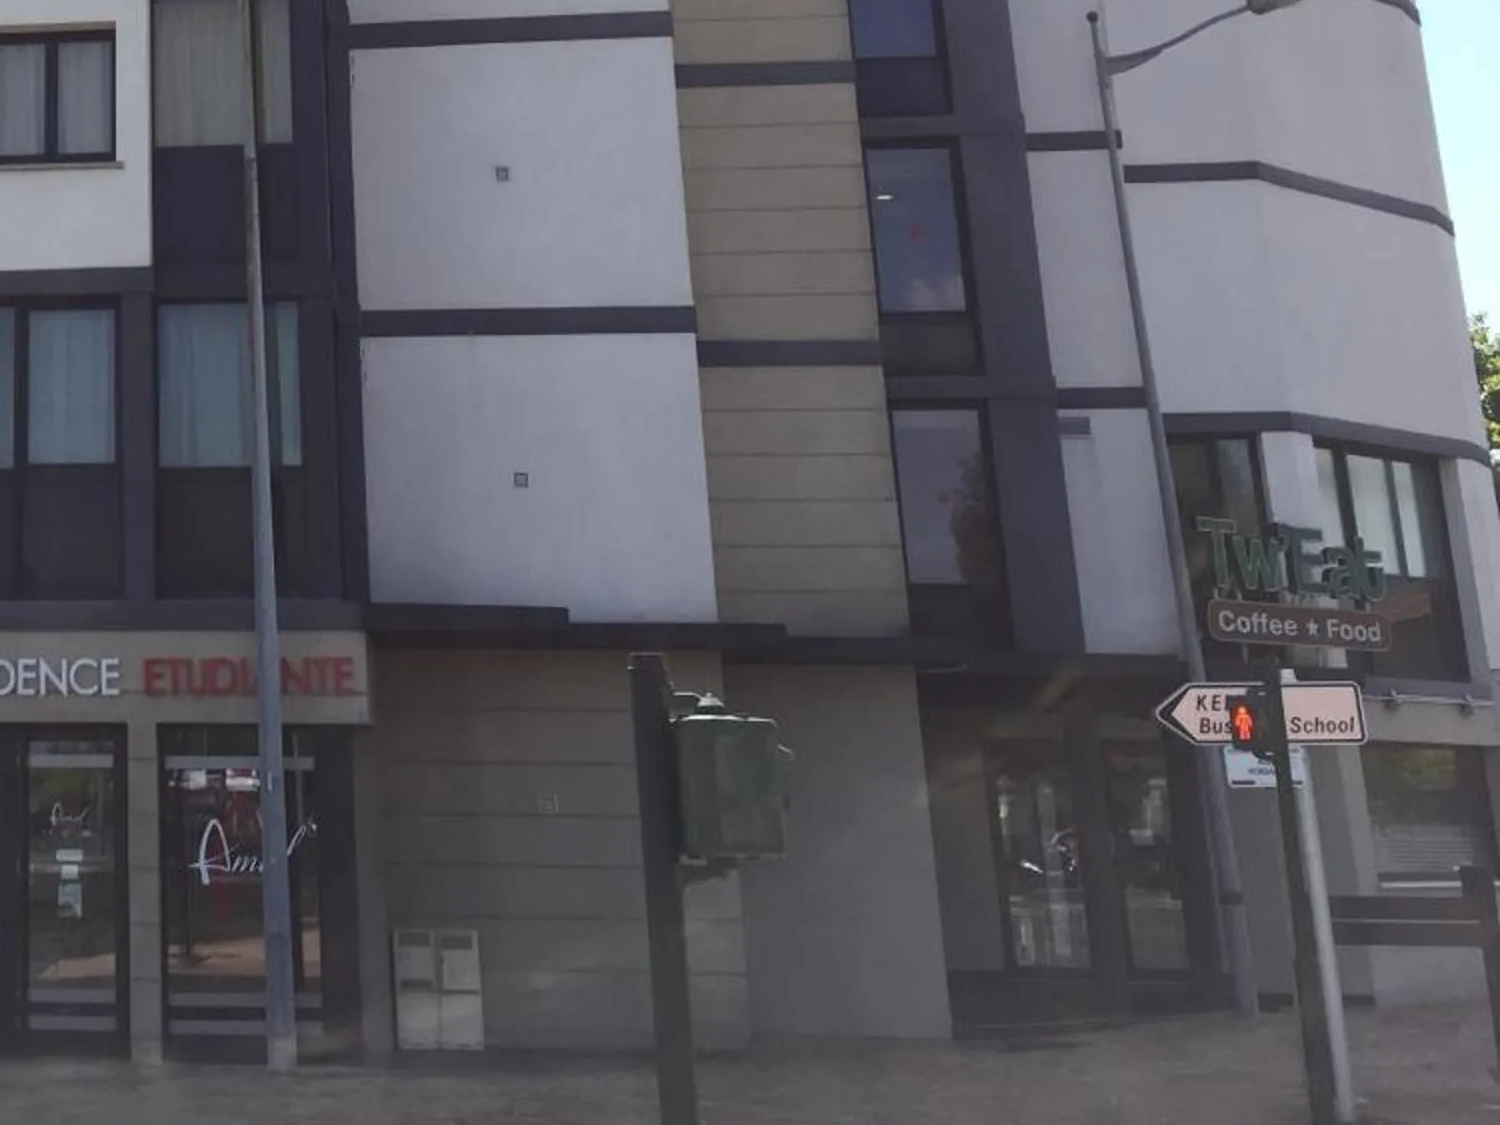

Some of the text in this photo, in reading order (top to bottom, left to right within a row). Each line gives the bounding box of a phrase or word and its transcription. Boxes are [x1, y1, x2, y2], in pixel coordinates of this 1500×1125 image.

[1218, 610, 1381, 642] Coffee Food
[141, 655, 355, 698] ETUDINTE
[1289, 716, 1355, 735] School
